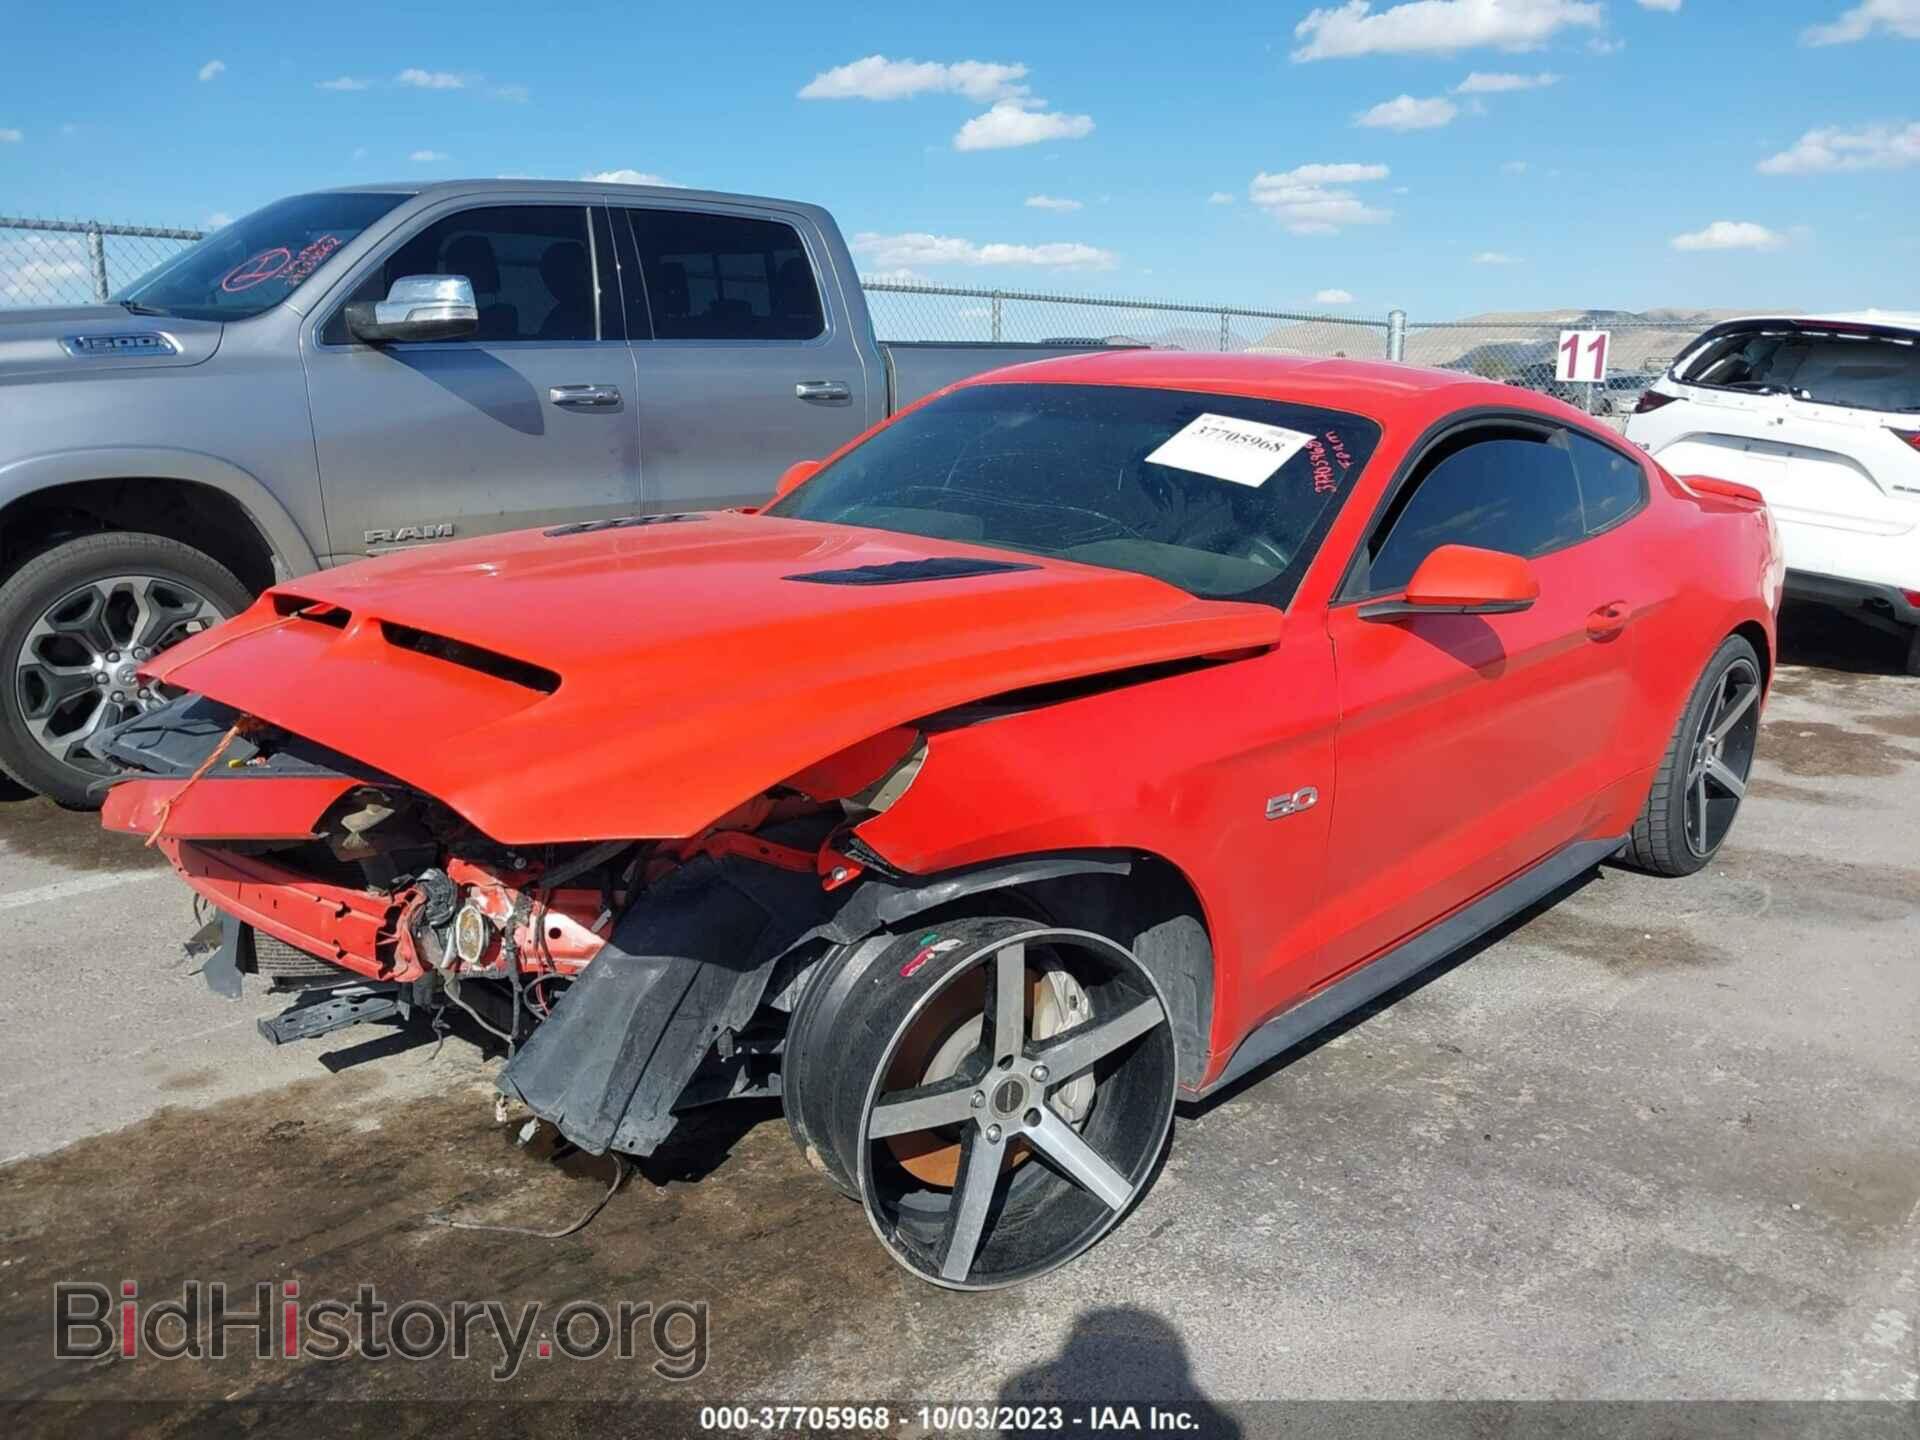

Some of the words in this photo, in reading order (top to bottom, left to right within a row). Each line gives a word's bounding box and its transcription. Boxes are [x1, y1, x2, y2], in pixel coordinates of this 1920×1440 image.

[1561, 334, 1606, 379] 11
[1192, 425, 1286, 453] 37705968
[364, 523, 454, 544] RAM
[1265, 786, 1318, 820] 5.0
